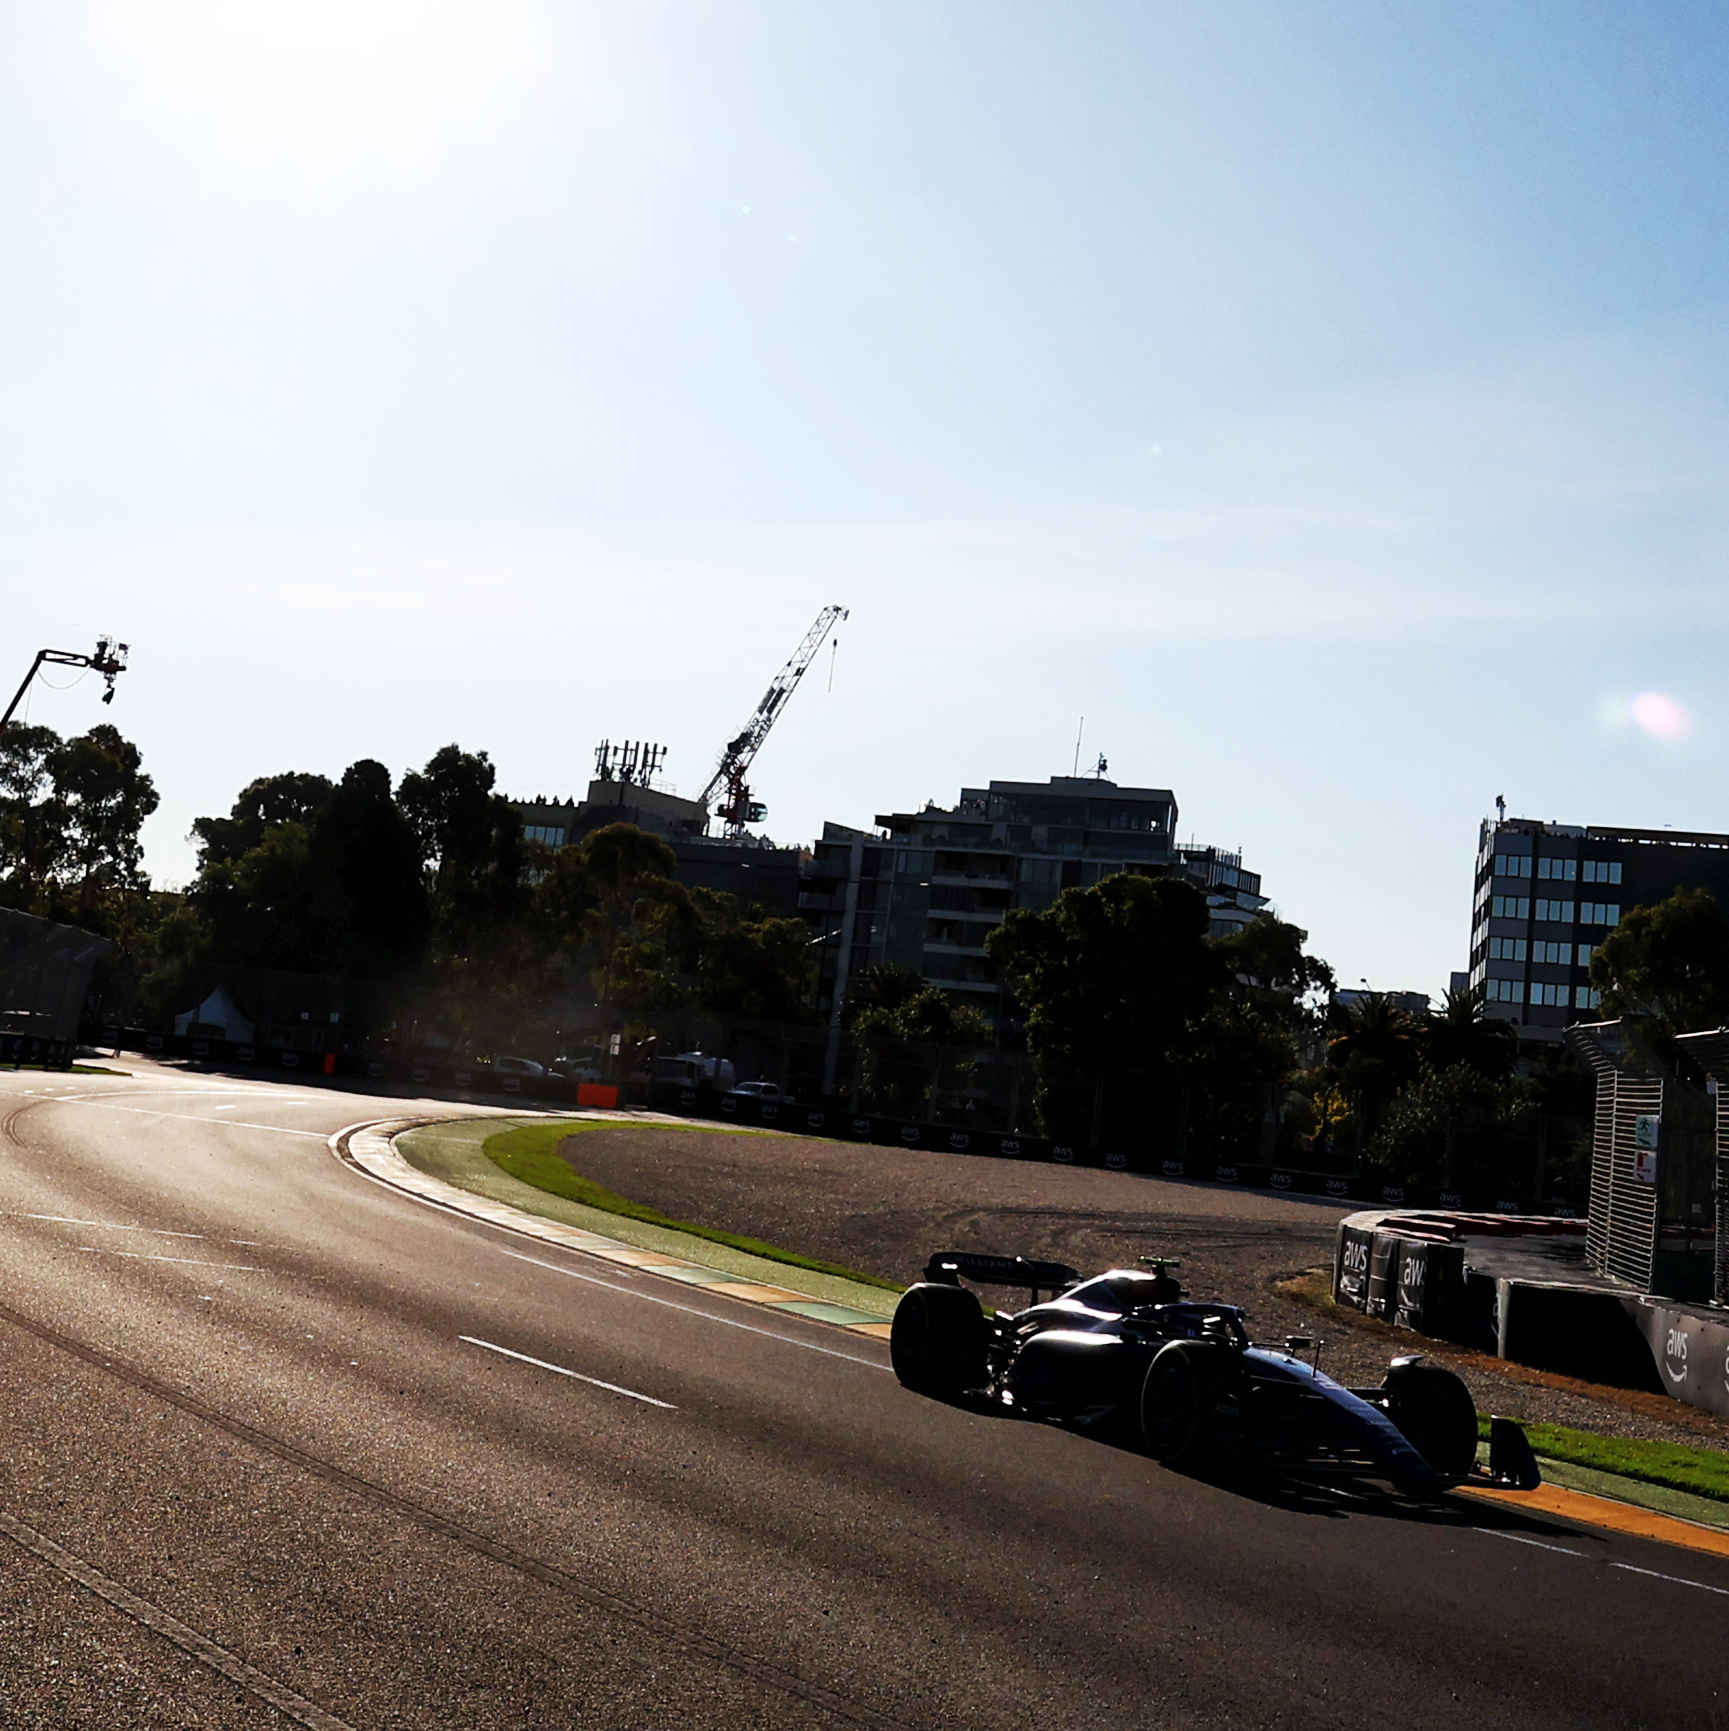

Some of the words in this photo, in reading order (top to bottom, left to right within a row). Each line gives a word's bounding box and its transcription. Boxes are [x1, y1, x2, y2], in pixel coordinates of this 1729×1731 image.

[1326, 1179, 1347, 1191] aws
[1382, 1186, 1404, 1197] aws
[1439, 1193, 1461, 1204] aws
[1496, 1200, 1518, 1211] aws
[1554, 1207, 1576, 1218] aws
[1343, 1240, 1368, 1271] aws
[1666, 1328, 1688, 1360] aws
